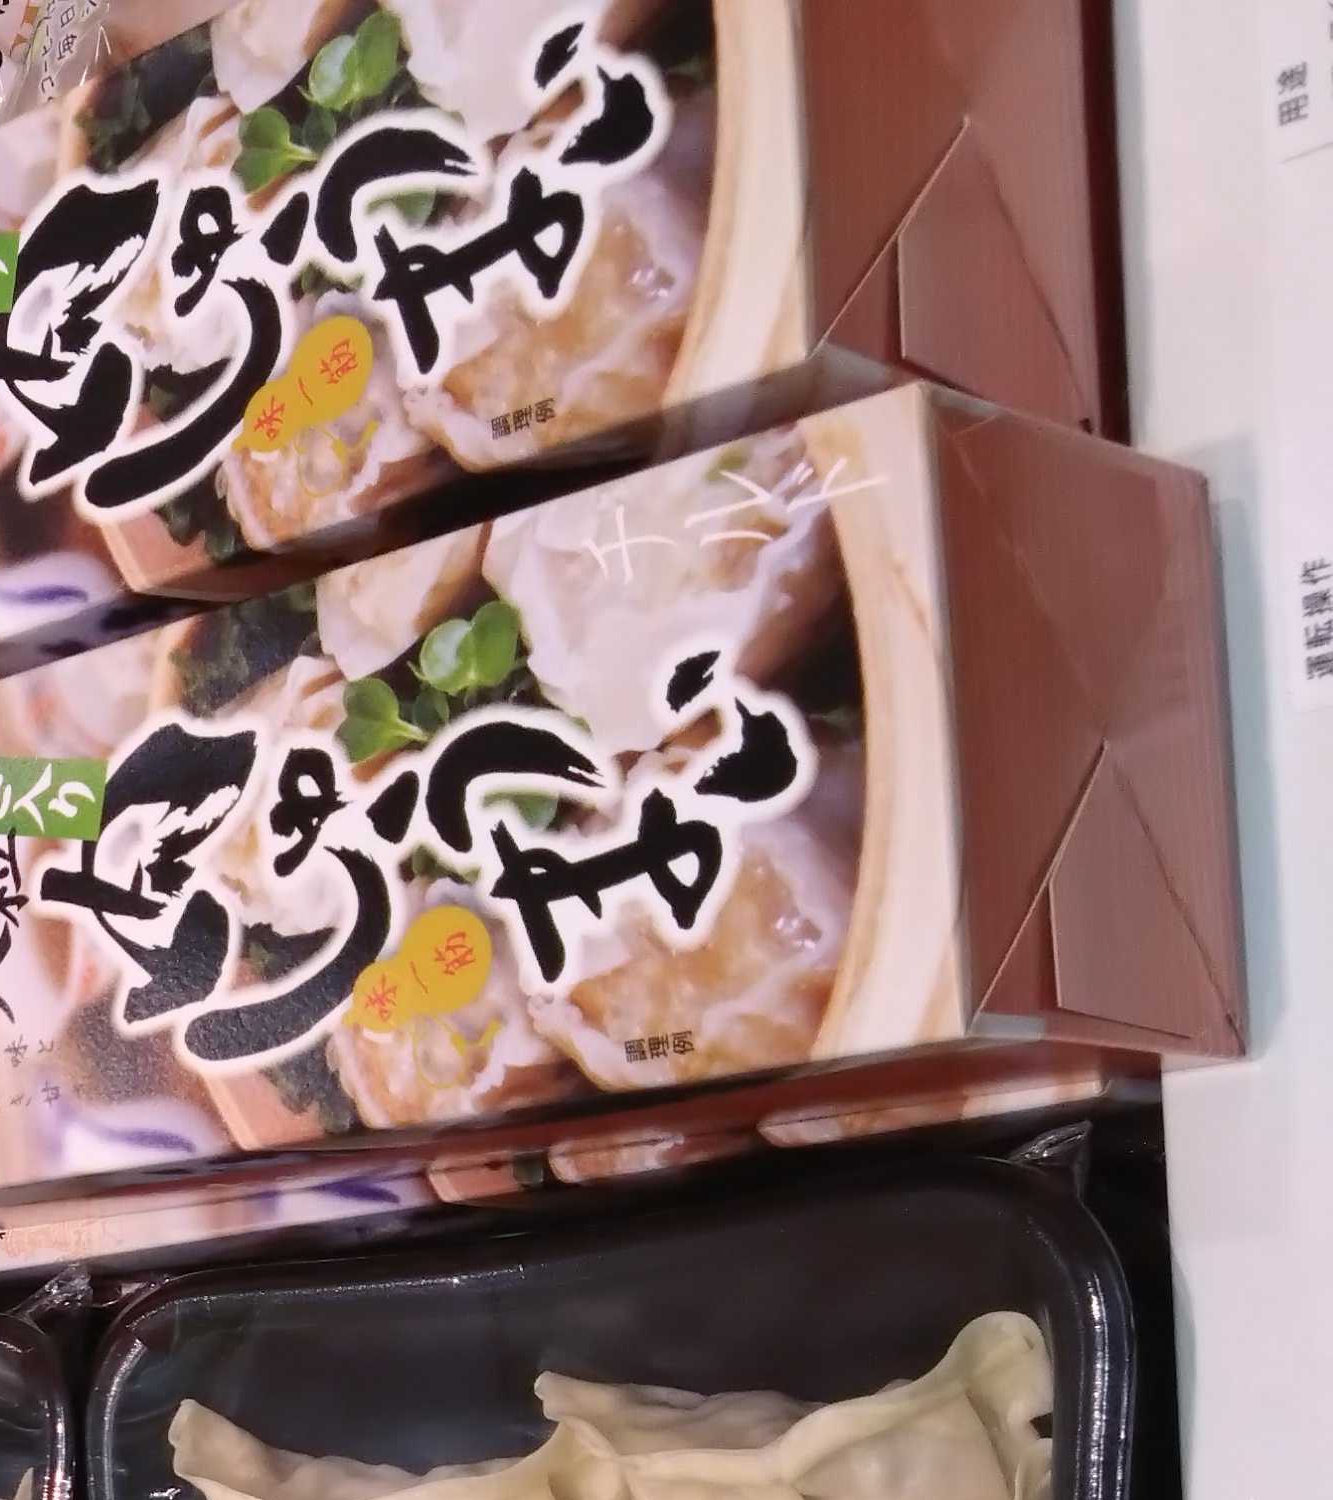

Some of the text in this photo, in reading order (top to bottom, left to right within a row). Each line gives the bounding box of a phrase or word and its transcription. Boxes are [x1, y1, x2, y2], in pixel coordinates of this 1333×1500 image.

[251, 338, 360, 439] 味一筋
[582, 456, 889, 584] チルド
[364, 929, 474, 1022] 味一筋
